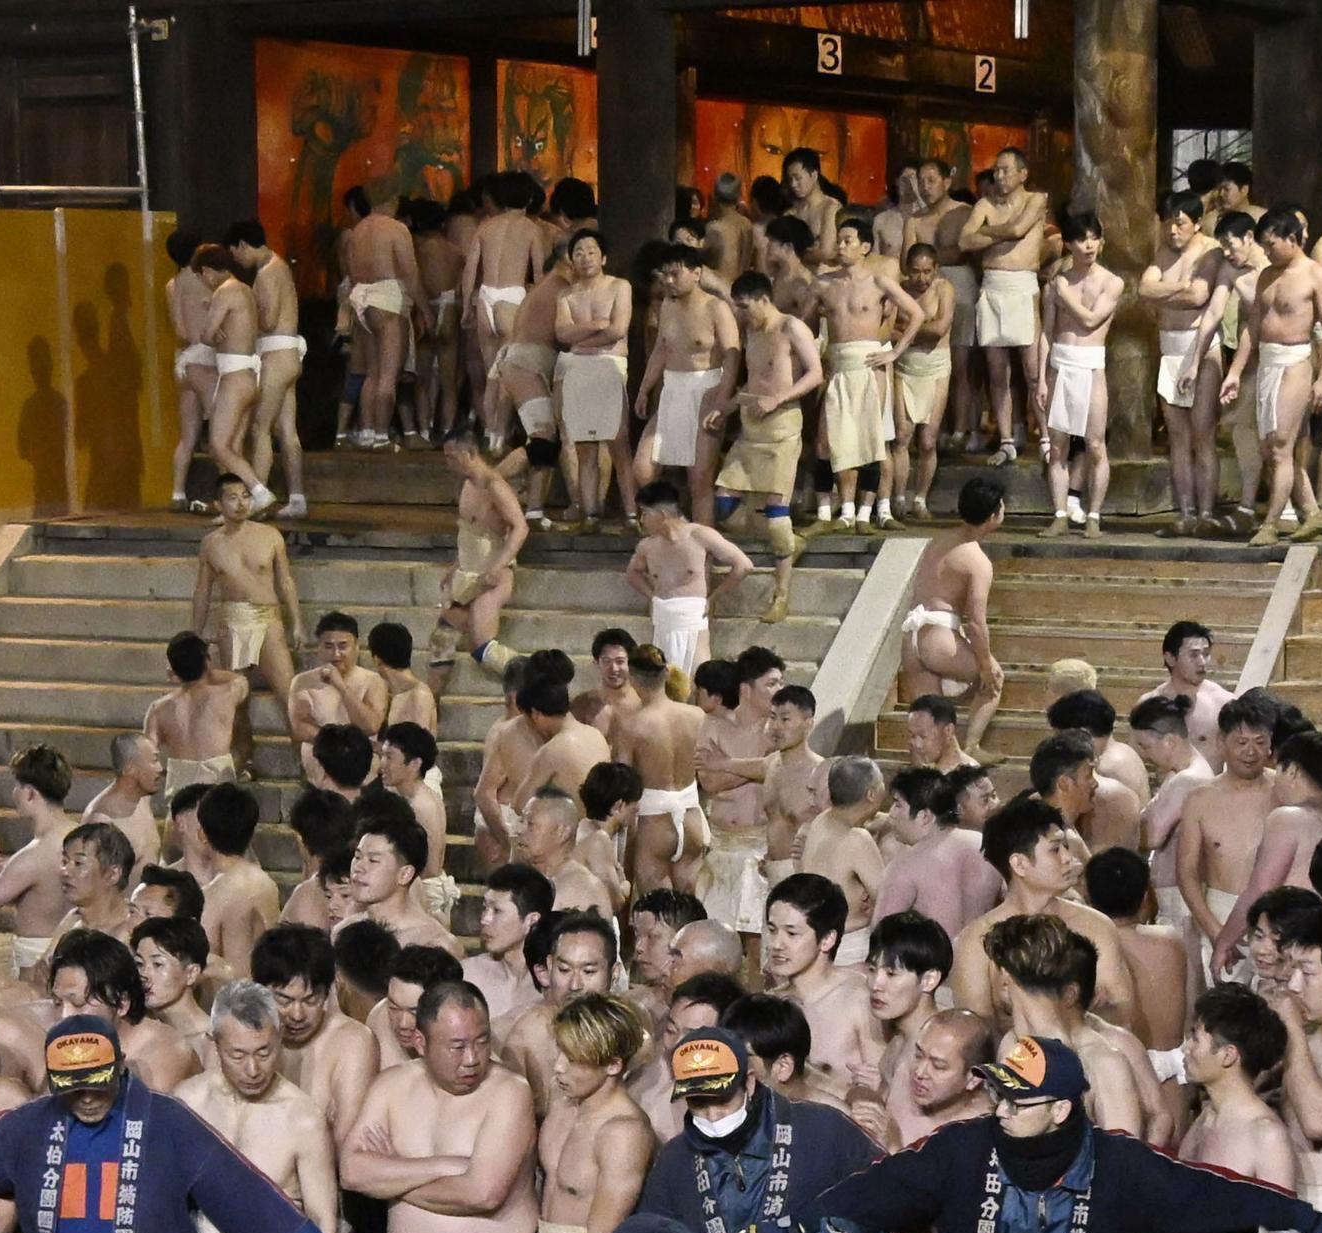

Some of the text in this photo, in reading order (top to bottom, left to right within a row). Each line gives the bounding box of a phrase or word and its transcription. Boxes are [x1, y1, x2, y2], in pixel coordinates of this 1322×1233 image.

[820, 38, 841, 72] 3
[978, 58, 994, 90] 2
[56, 1037, 100, 1050] OKAYAMA
[679, 1043, 721, 1057] OKAYAMA
